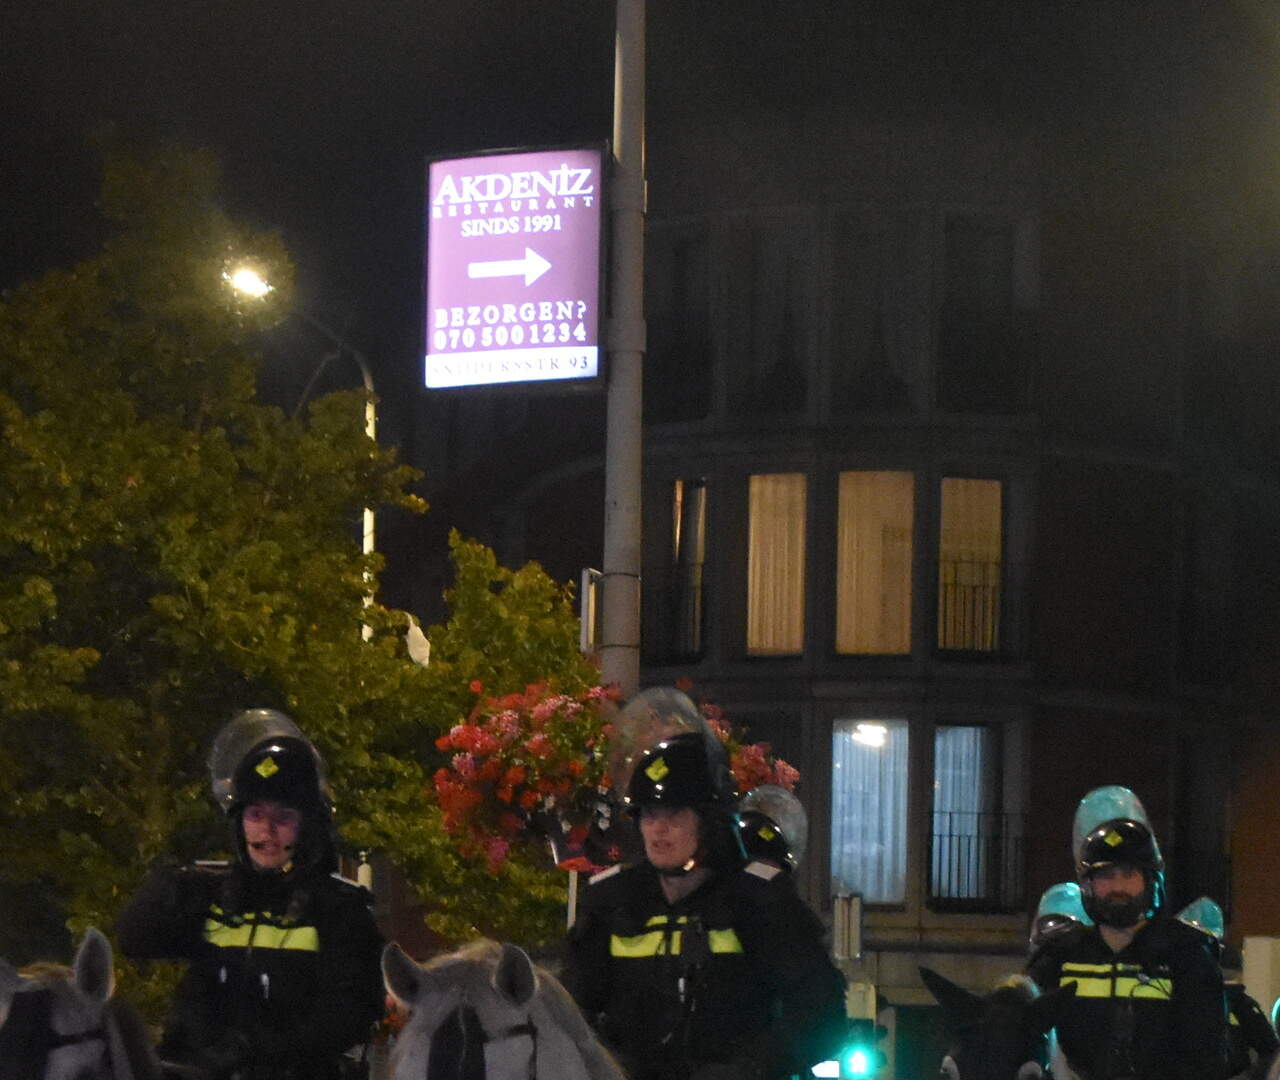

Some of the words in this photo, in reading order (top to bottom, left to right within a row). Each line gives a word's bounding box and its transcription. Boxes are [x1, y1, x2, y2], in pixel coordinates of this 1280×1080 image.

[432, 196, 594, 218] RESTAURANT
[461, 216, 520, 237] SINDS
[524, 214, 562, 233] 1991
[434, 301, 587, 329] BEZORGEN?
[433, 329, 476, 350] 070
[529, 322, 587, 345] 1234
